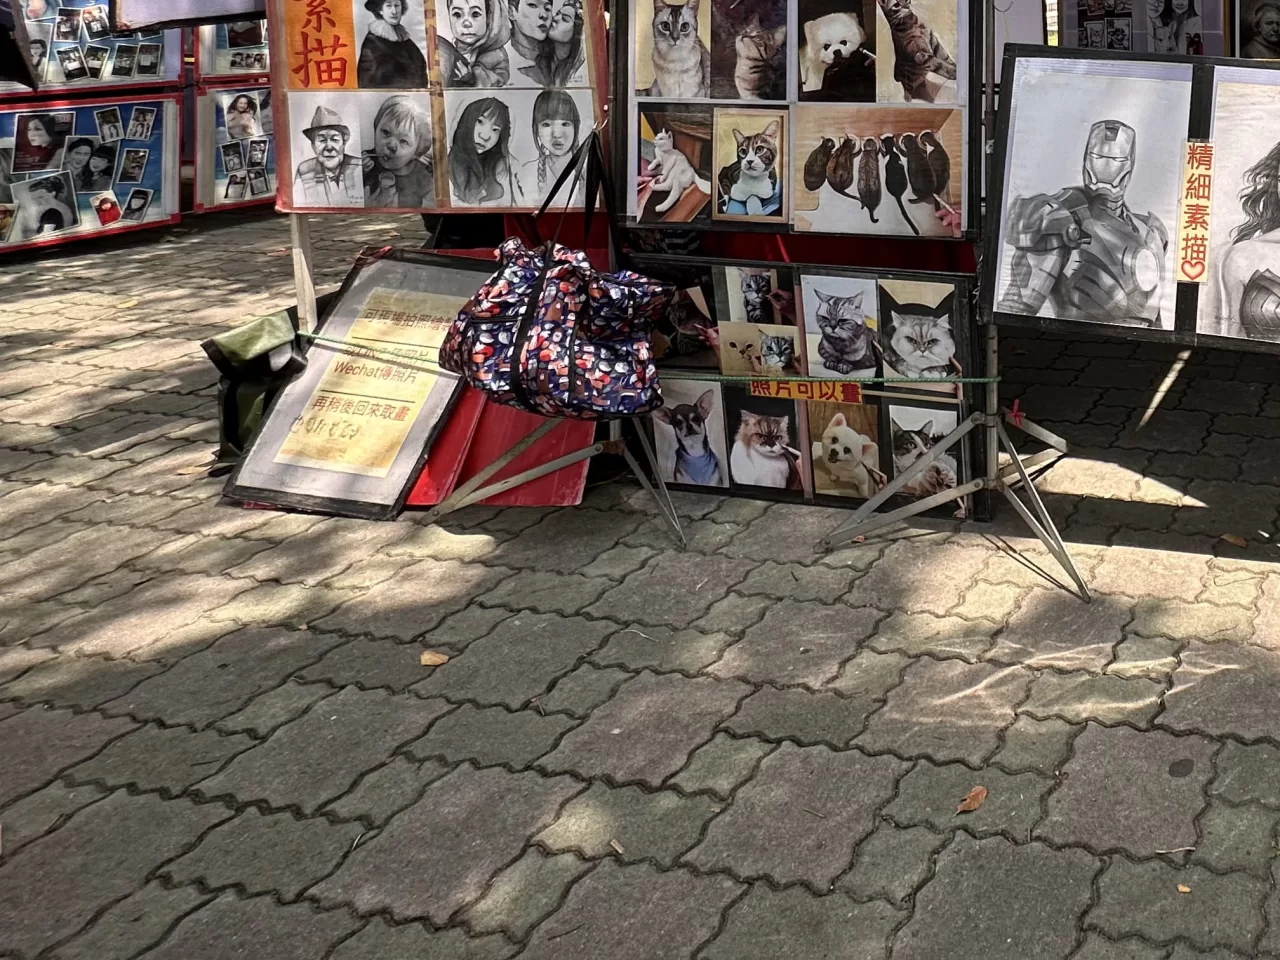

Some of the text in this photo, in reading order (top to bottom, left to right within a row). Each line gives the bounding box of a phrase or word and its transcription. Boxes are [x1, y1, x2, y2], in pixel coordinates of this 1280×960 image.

[1181, 143, 1214, 262] 精細素描
[751, 379, 861, 404] 照片可以畫
[312, 395, 411, 422] 再稍後回來取畫
